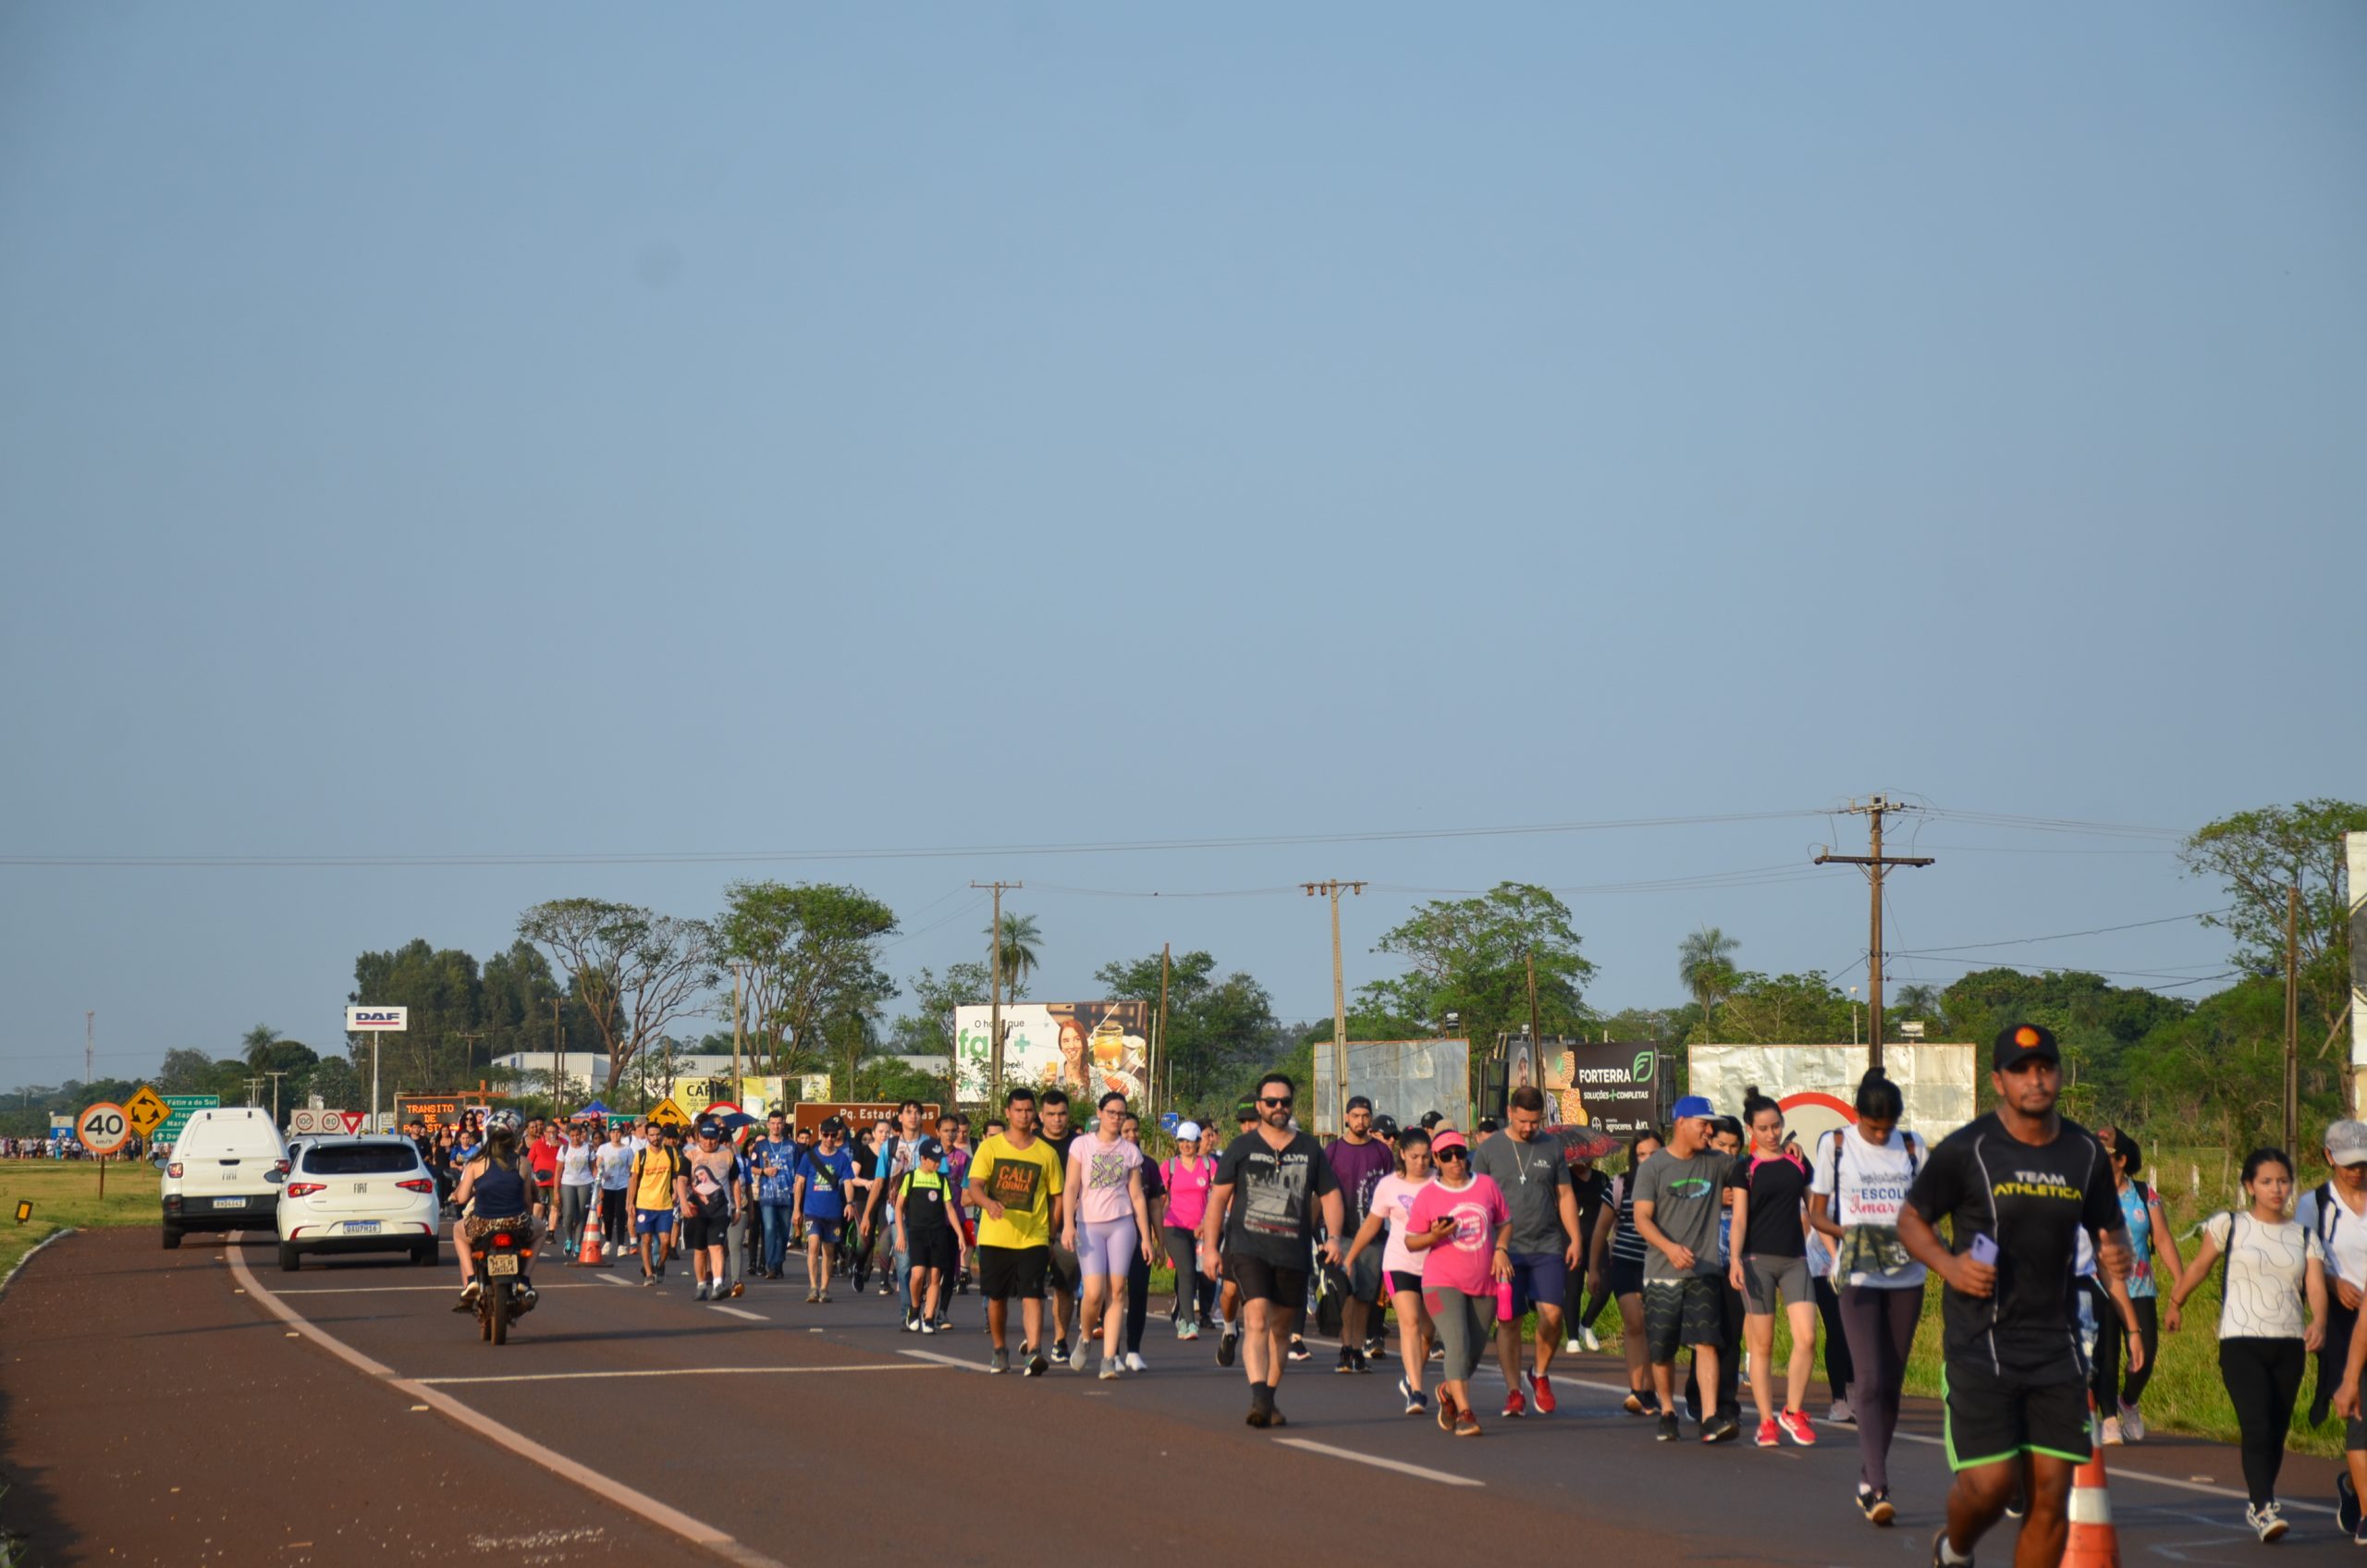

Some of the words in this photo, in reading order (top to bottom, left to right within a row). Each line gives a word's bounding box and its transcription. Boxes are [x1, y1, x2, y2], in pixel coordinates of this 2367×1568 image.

[355, 1012, 399, 1021] DAF
[975, 1020, 982, 1028] O
[1008, 1021, 1024, 1030] que
[958, 1028, 989, 1059] fa
[1578, 1069, 1632, 1084] FORTERRA
[406, 1104, 455, 1114] TRANSITO
[840, 1109, 856, 1121] Pq.
[84, 1115, 124, 1135] 40
[423, 1114, 436, 1123] DE
[999, 1165, 1034, 1183] CALI
[2015, 1170, 2067, 1186] TEAM
[353, 1182, 368, 1194] FIAT
[997, 1180, 1031, 1193] FORNIA
[1993, 1183, 2082, 1200] ATHLETICA
